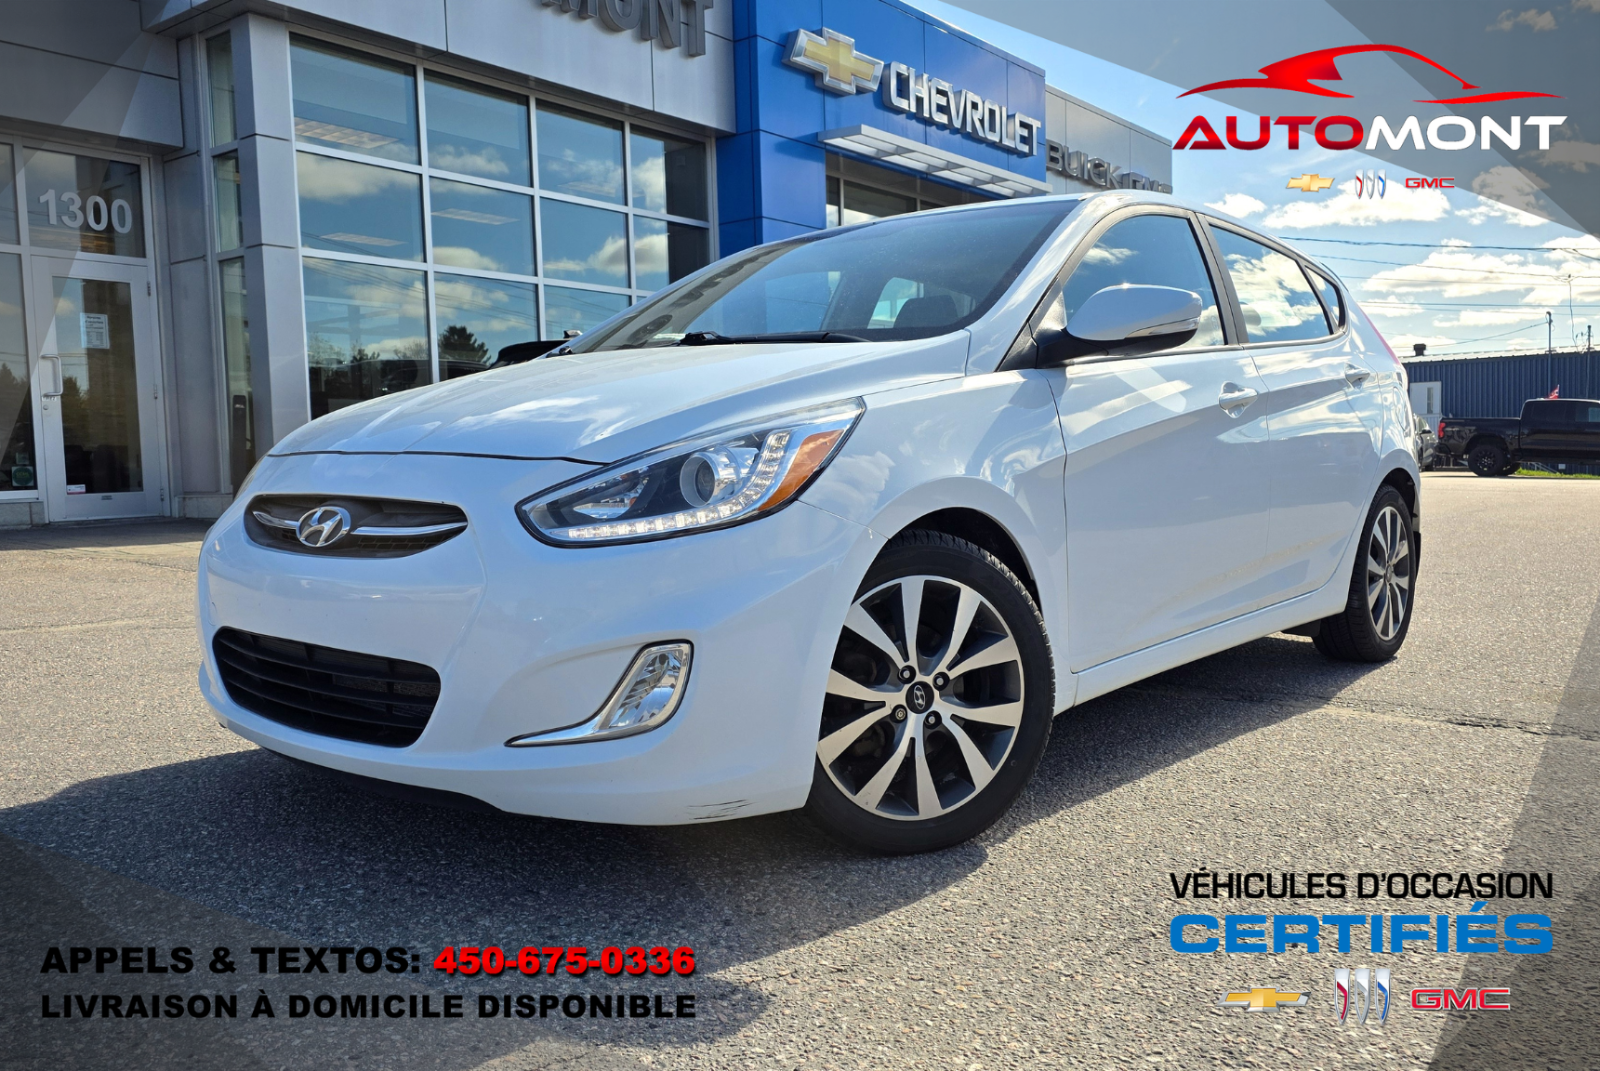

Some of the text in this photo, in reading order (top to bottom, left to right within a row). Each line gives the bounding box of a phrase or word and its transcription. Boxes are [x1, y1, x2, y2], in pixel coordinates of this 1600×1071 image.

[542, 0, 713, 57] ONT
[883, 60, 1042, 156] CHEVROLET
[1046, 139, 1121, 190] BUICK
[39, 188, 132, 234] 1300
